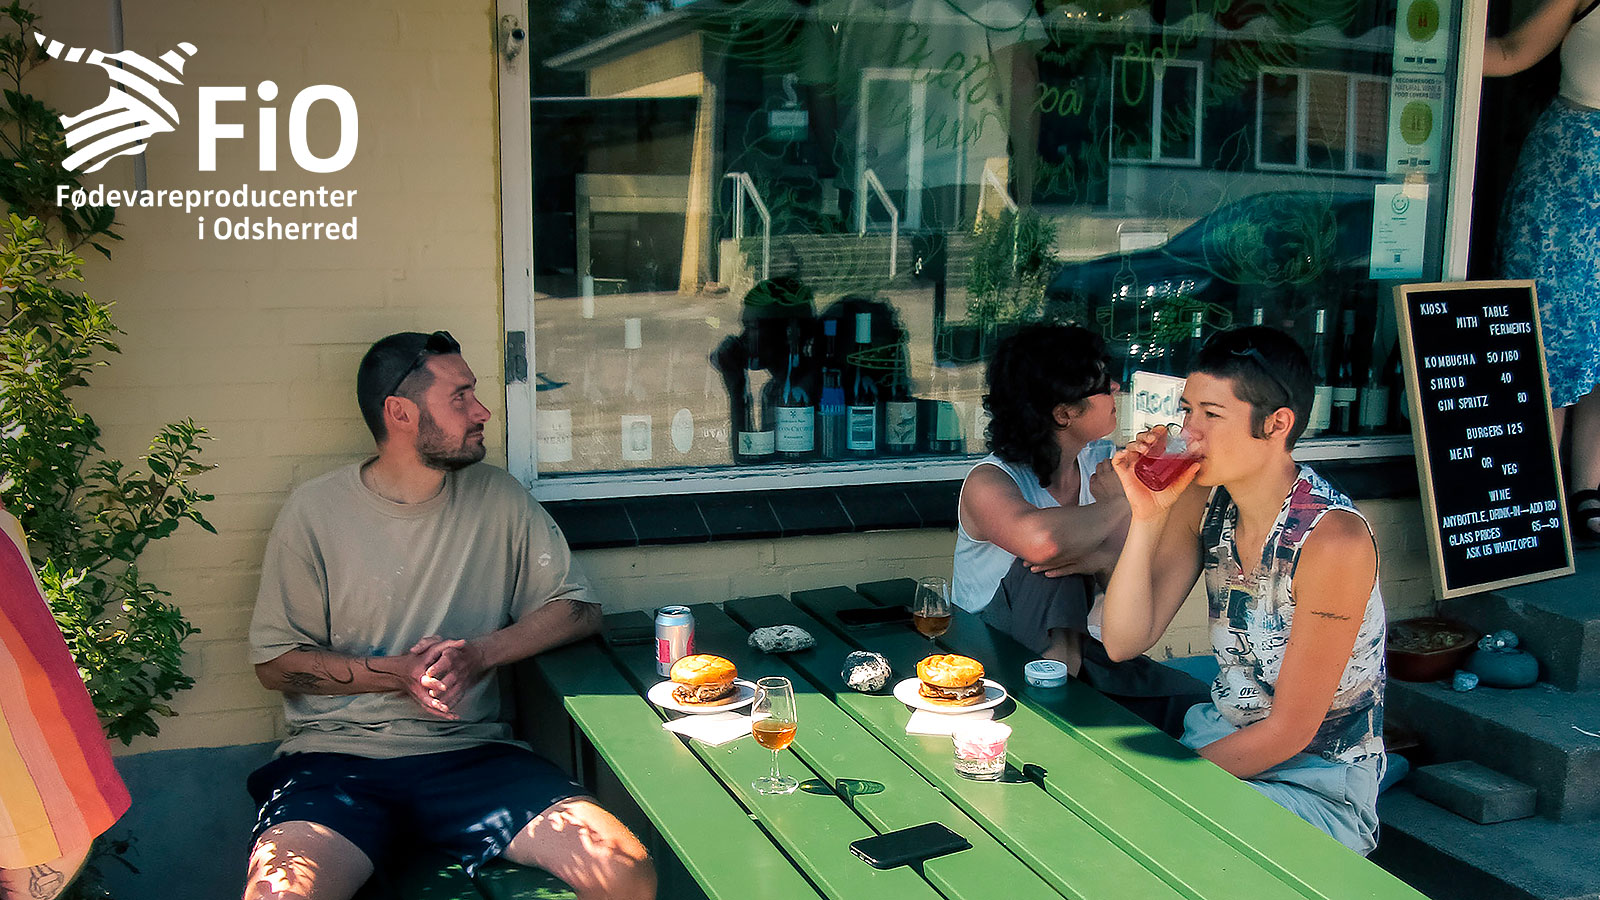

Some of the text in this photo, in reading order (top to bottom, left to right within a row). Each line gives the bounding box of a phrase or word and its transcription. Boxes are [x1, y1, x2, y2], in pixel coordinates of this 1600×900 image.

[1482, 305, 1510, 318] TABLE
[1489, 322, 1532, 336] FERMENTS
[1424, 353, 1477, 369] KOMBUCHA
[1430, 372, 1512, 391] SHRUB 40
[1438, 392, 1528, 412] GIN SPRITZ 80
[1466, 422, 1523, 440] BURGERS 125
[1450, 446, 1473, 461] MEAT
[1481, 457, 1493, 469] OR
[1502, 463, 1518, 475] VEG
[1488, 488, 1512, 502] WINE
[1544, 500, 1557, 511] 180
[1449, 531, 1474, 547] GLASS
[1475, 527, 1501, 542] PRICES
[1466, 536, 1539, 559] ASK US WHATZ OPEN
